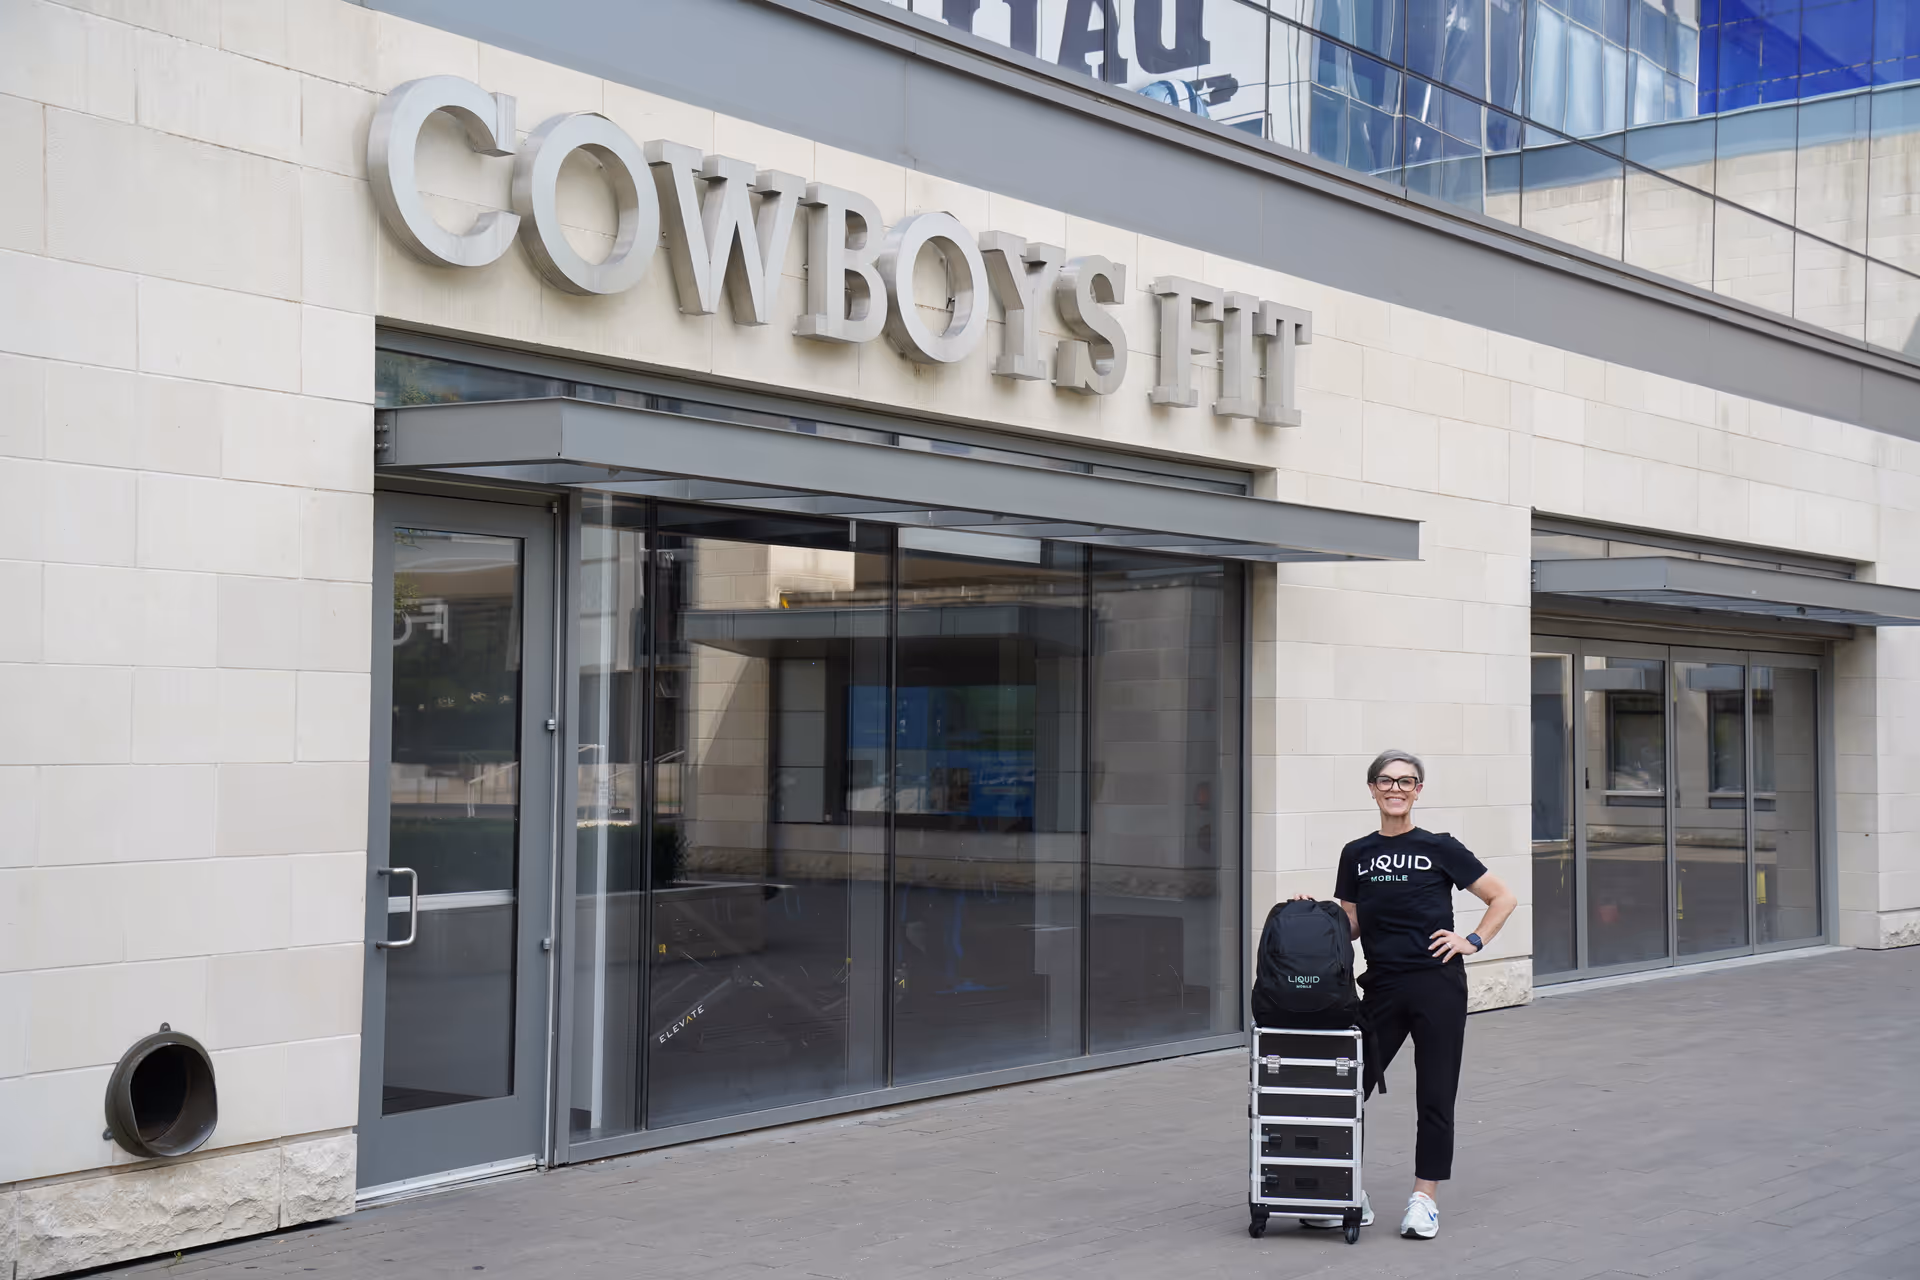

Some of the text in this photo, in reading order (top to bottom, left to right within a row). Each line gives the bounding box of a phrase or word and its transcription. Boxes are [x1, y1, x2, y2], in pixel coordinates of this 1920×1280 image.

[367, 75, 1312, 427] COWBOYS FIT
[1357, 853, 1432, 876] LIQUID
[1370, 874, 1409, 882] MOBILE
[1287, 975, 1321, 984] LIQUID
[658, 1004, 705, 1044] ELEVATE
